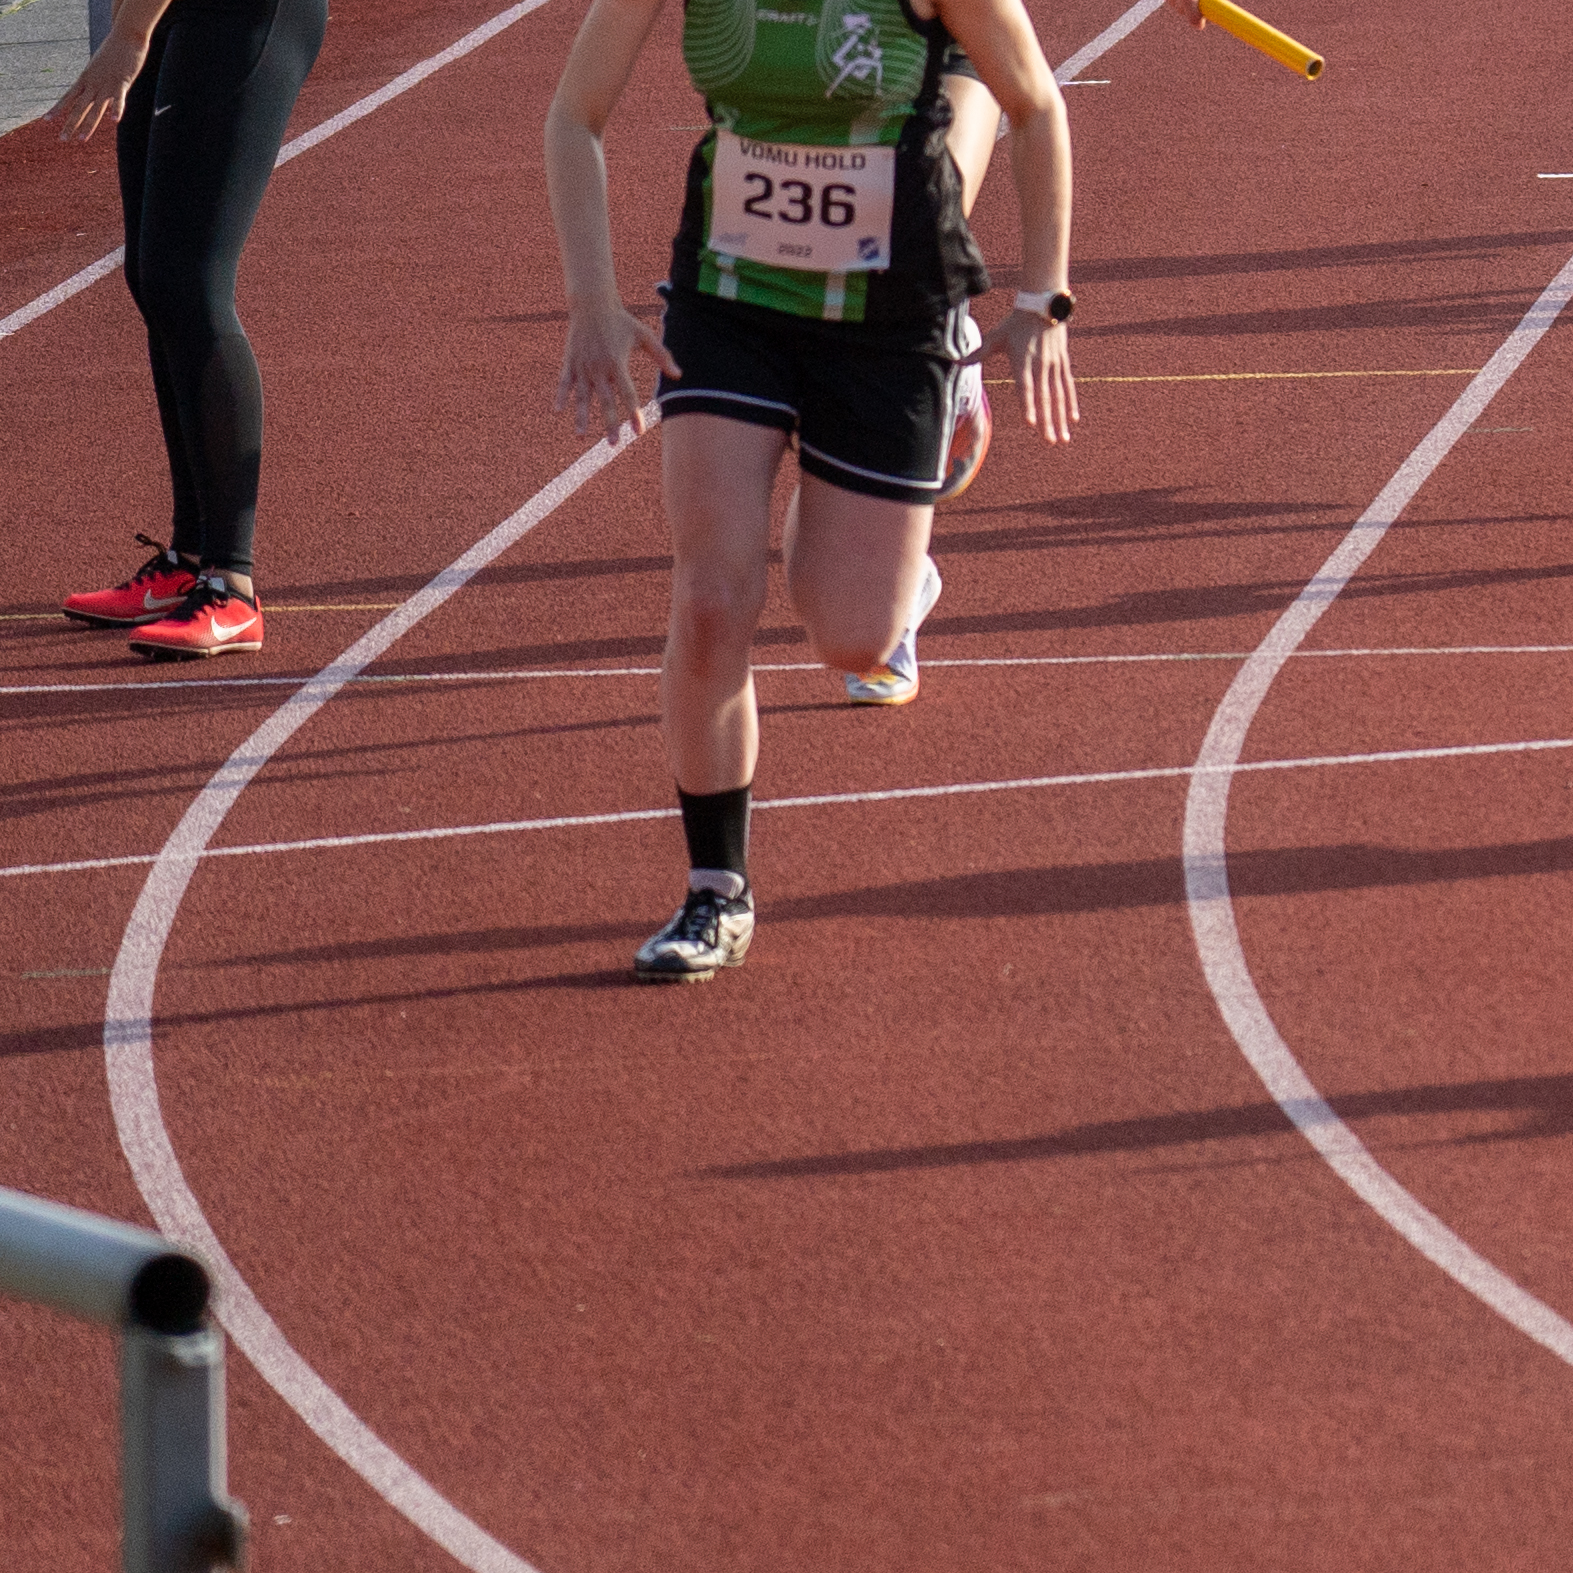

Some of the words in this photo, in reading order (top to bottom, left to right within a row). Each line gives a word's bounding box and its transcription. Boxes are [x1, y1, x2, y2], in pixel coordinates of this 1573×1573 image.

[739, 139, 799, 169] VDMU
[804, 153, 867, 171] HOLD
[742, 172, 857, 230] 236
